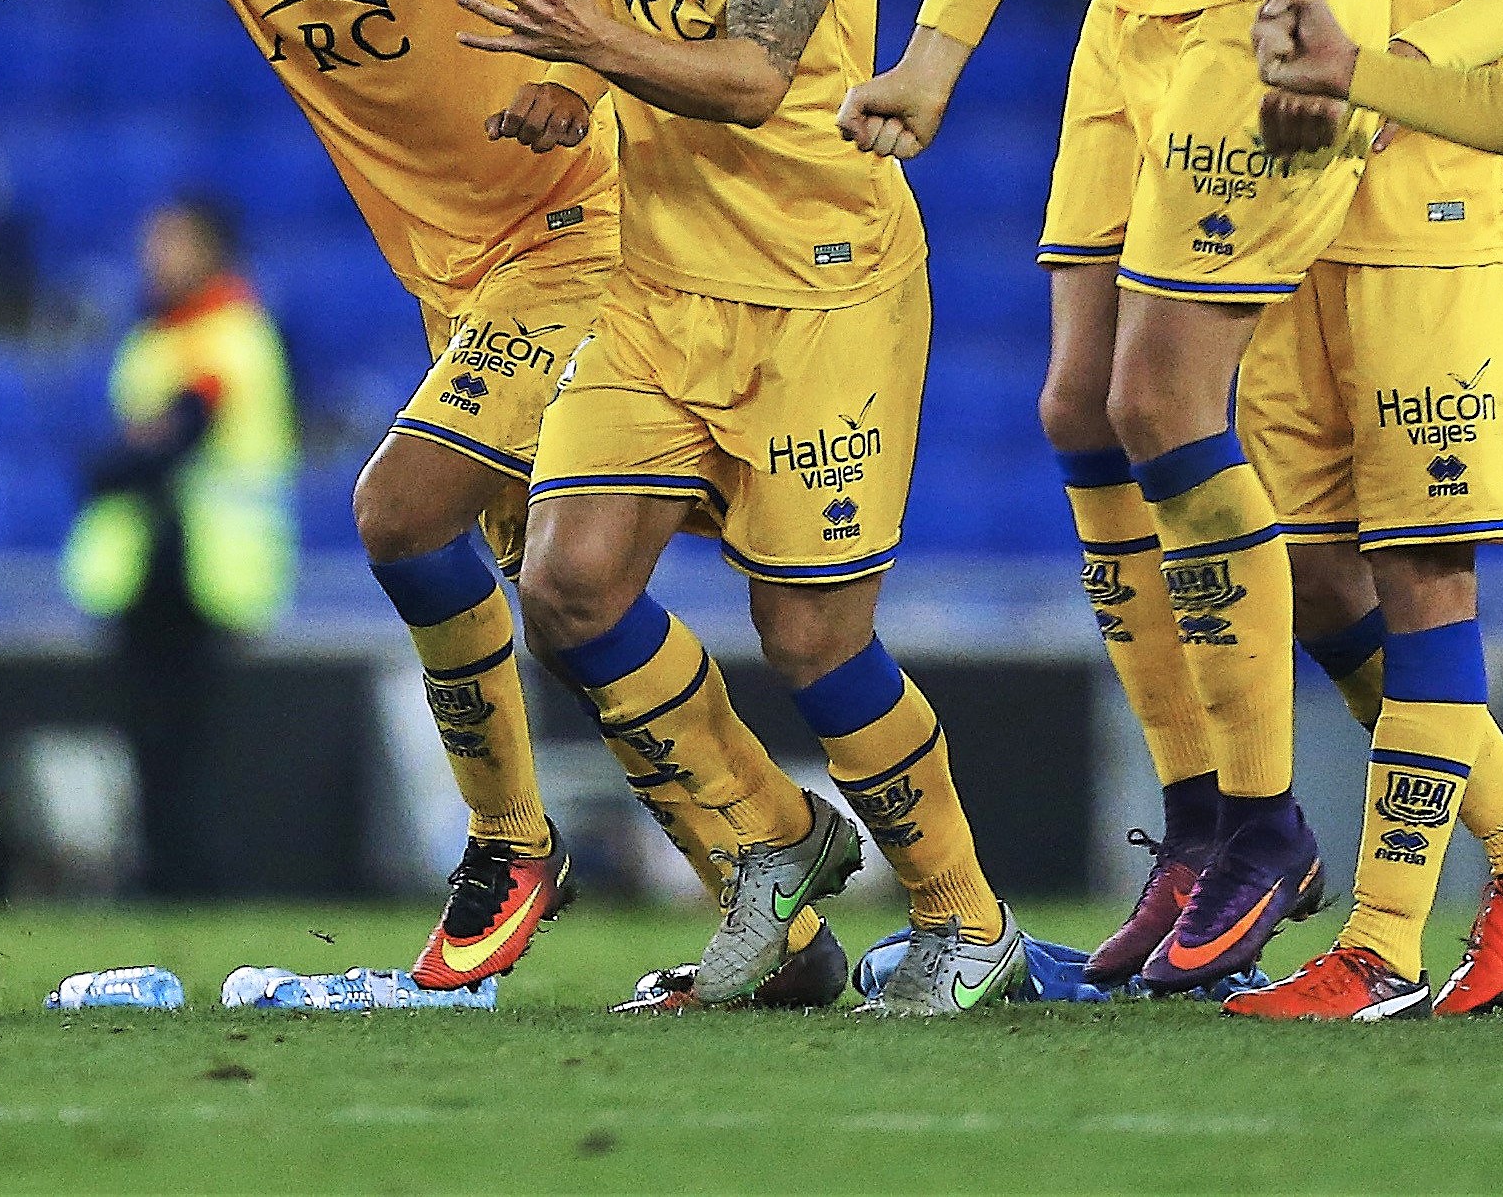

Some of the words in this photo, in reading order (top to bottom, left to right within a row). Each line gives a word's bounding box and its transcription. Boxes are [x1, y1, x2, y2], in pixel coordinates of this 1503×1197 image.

[1192, 174, 1258, 205] viajes
[451, 350, 518, 378] viajes
[439, 391, 481, 416] errea
[1407, 424, 1477, 452] viajes
[801, 462, 865, 493] viajes
[1428, 481, 1469, 498] errea
